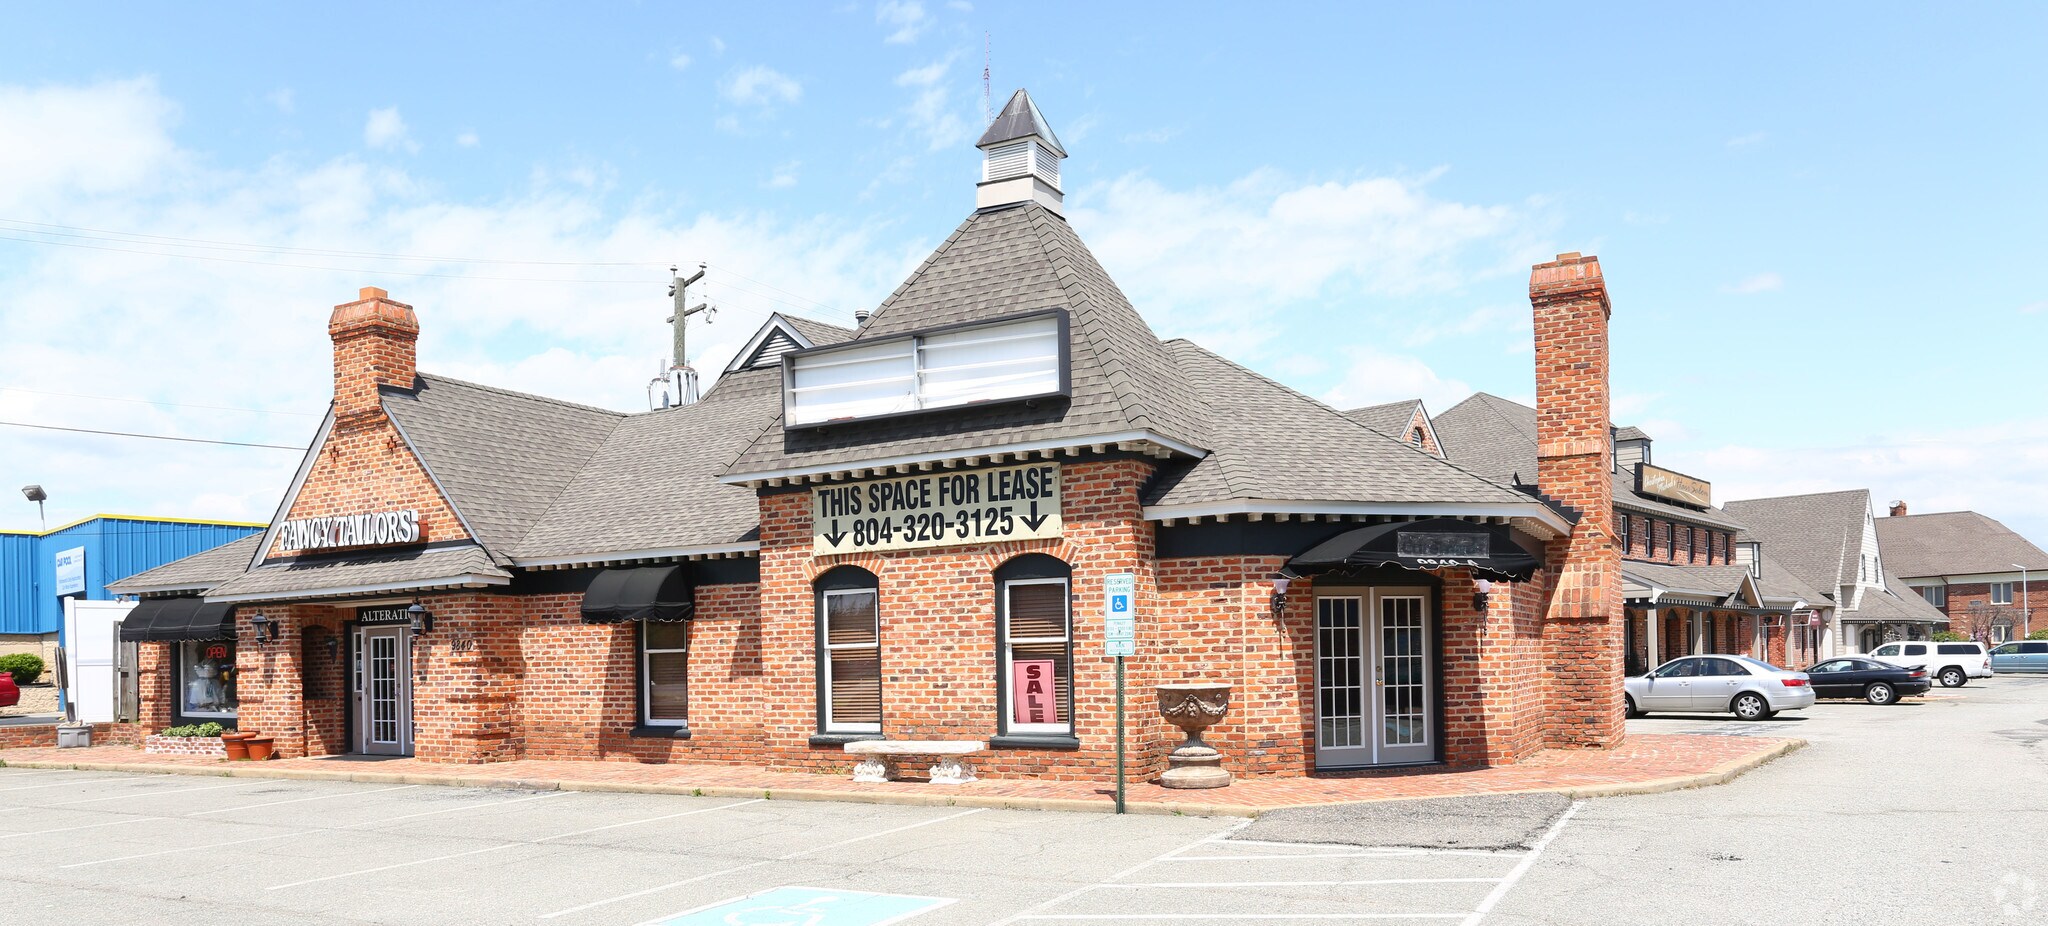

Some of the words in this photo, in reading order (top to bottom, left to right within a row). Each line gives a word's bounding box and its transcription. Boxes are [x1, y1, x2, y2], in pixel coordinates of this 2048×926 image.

[818, 486, 862, 518] THIS
[868, 478, 931, 514] SPACE
[938, 472, 979, 507] FOR
[987, 467, 1053, 501] LEASE
[279, 517, 336, 551] FANCY
[335, 510, 419, 546] TAILORS
[853, 506, 1014, 547] 804-320-3125
[1106, 577, 1132, 585] RESERVED
[1108, 586, 1131, 594] PARKING
[206, 646, 227, 659] OPEN
[450, 639, 473, 651] 9840
[1026, 664, 1045, 723] SALE
